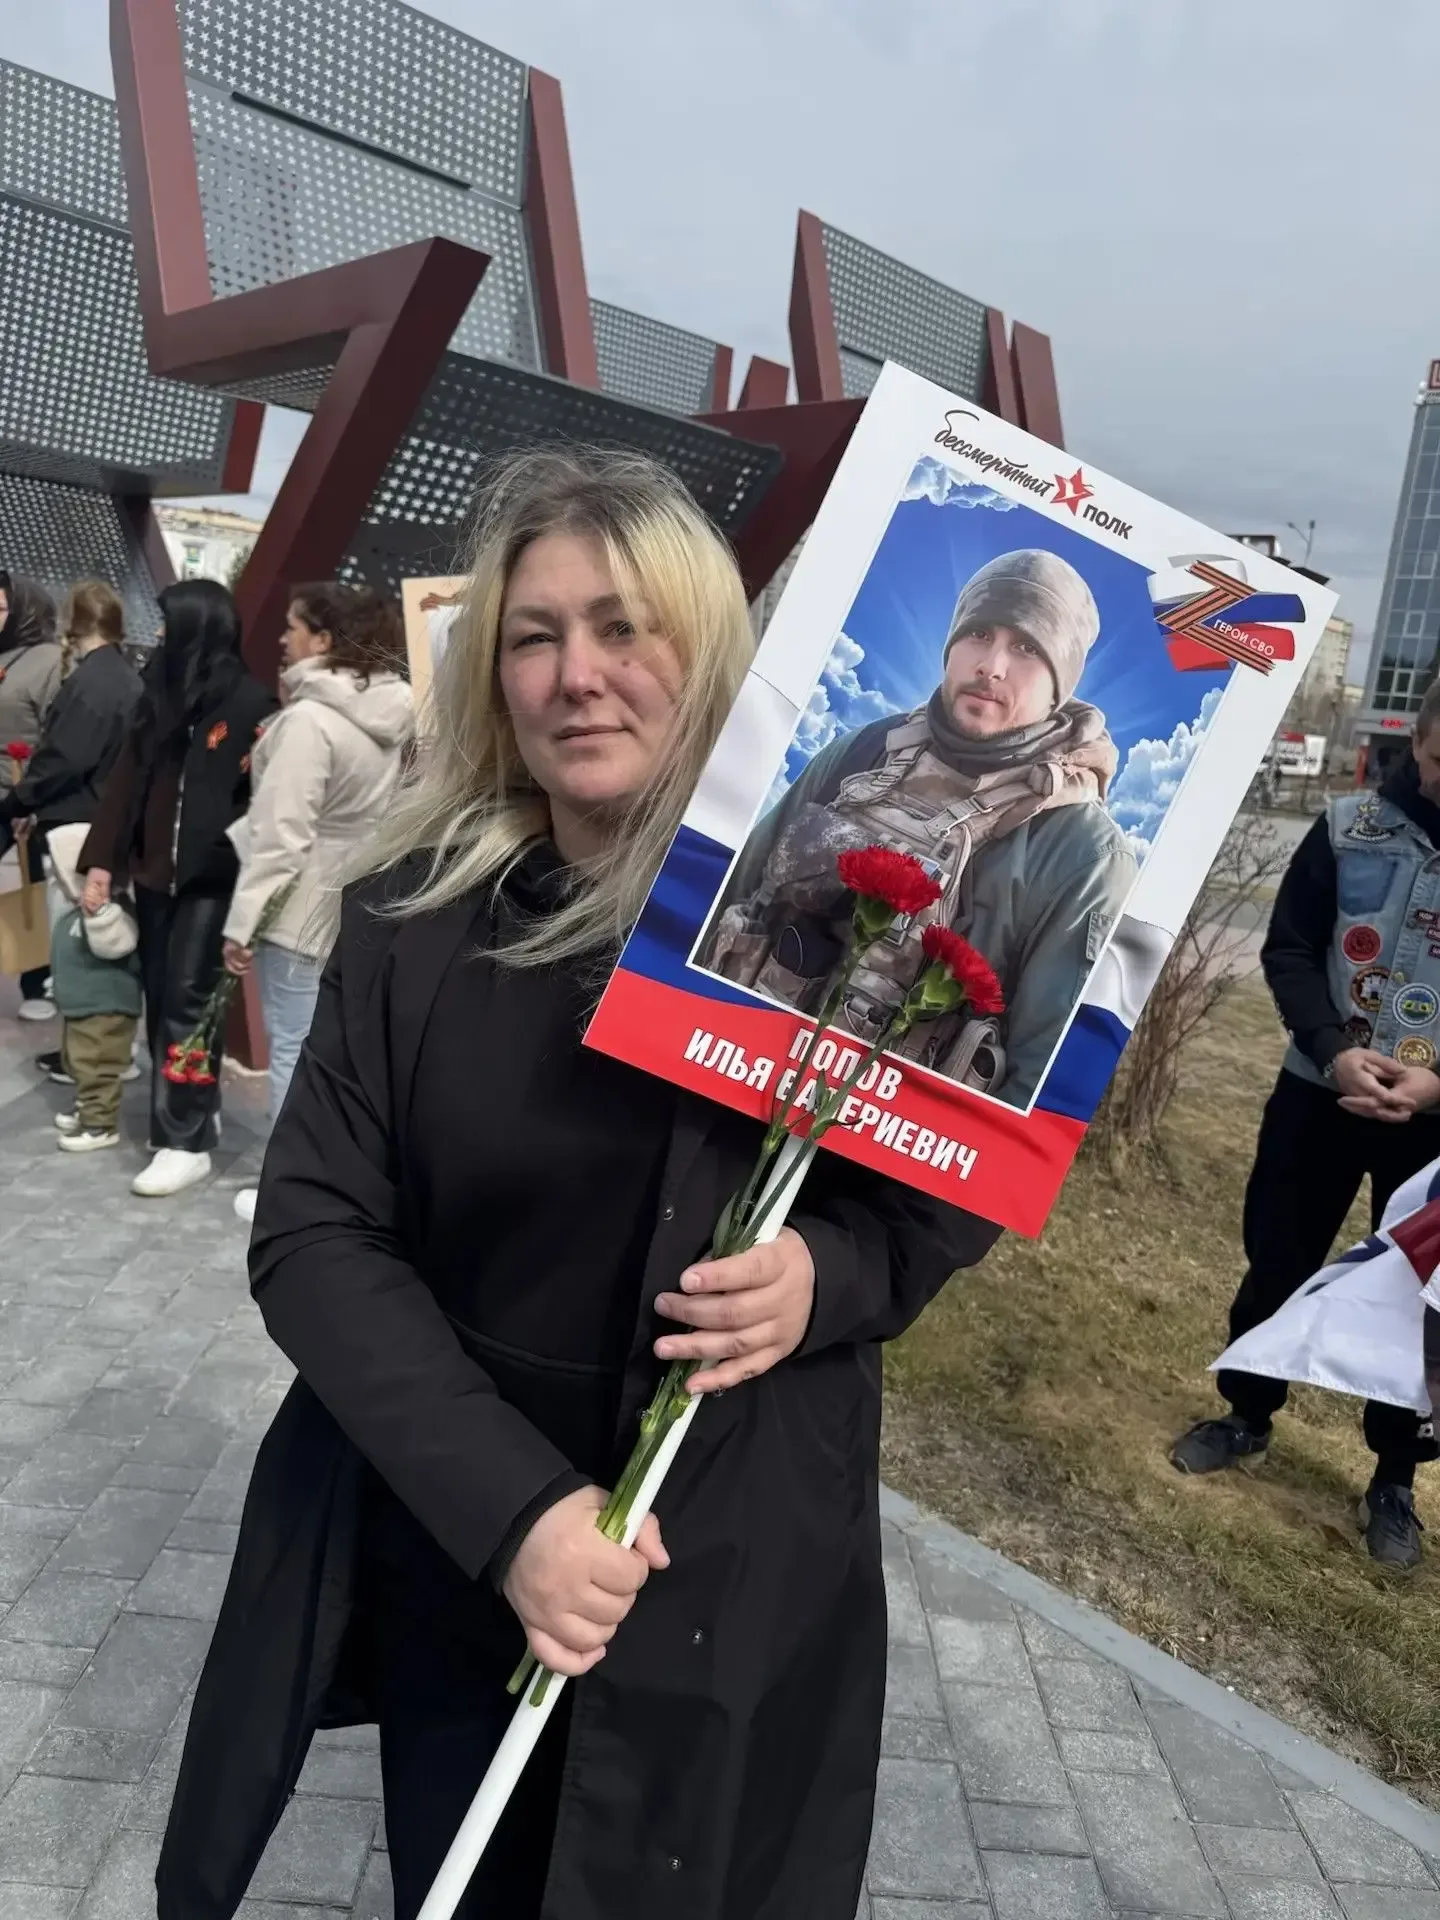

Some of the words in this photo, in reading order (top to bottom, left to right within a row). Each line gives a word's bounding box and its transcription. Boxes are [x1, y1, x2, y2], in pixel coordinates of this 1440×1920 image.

[1082, 504, 1133, 540] ПОЛК
[1213, 619, 1249, 644] ГЕРОИ
[1250, 638, 1275, 656] СВО
[787, 1027, 903, 1101] ПОПОВ
[682, 1027, 776, 1092] ИЛЬЯ
[775, 1067, 979, 1181] ВАЕРИЕВИЧ
